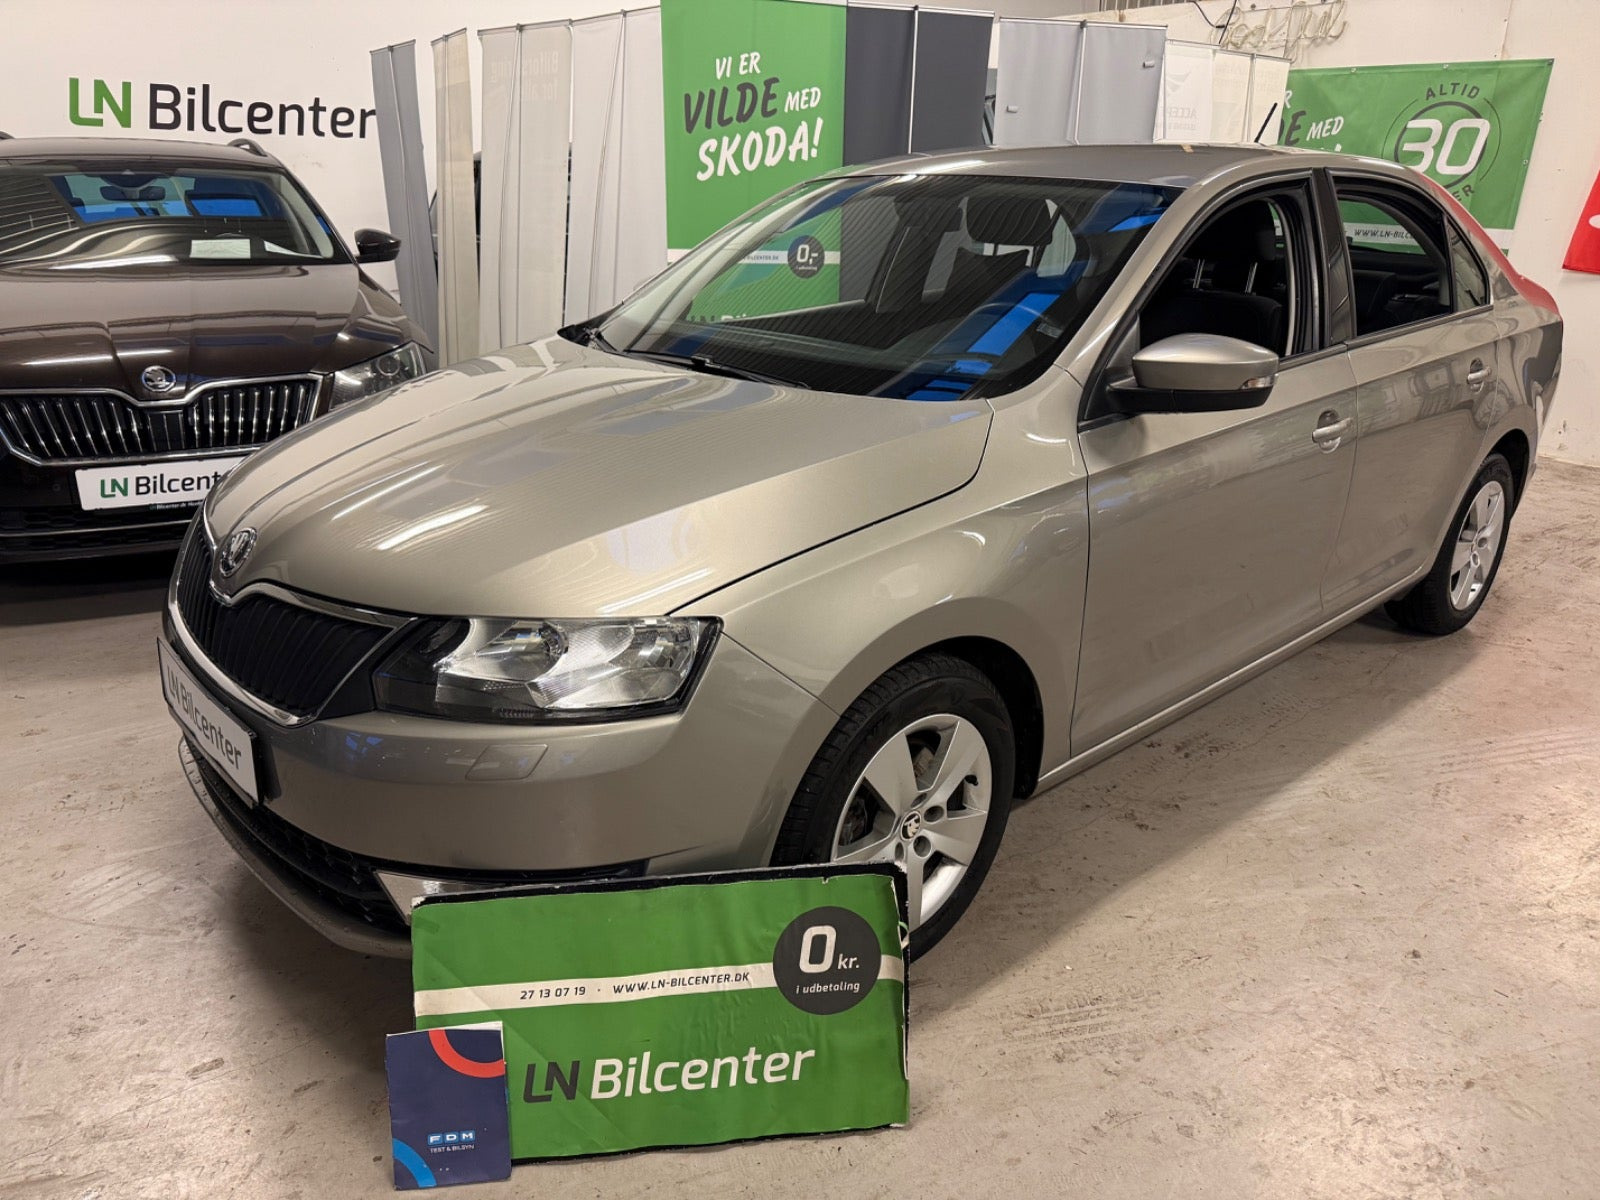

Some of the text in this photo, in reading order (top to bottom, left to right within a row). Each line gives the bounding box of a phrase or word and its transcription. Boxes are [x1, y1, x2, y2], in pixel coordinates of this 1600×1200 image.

[715, 51, 761, 80] VI ER
[684, 77, 822, 134] VILDE MED
[1426, 82, 1480, 101] ALTID
[69, 77, 377, 139] LN Bilcenter
[1306, 116, 1344, 141] MED
[696, 117, 824, 181] SKODA!
[1402, 118, 1491, 175] 30
[1452, 184, 1475, 201] ER
[1354, 229, 1414, 239] WWW.LN-BILC
[100, 471, 222, 498] LN Bilcent
[167, 665, 242, 770] LN Bilcenter
[799, 925, 860, 973] 0 kr.
[520, 971, 750, 1000] 27 13 07 19 WWW.LN-BILCENTER.DK
[795, 981, 860, 994] i udbetaling
[523, 1046, 815, 1103] LN Bilcenter
